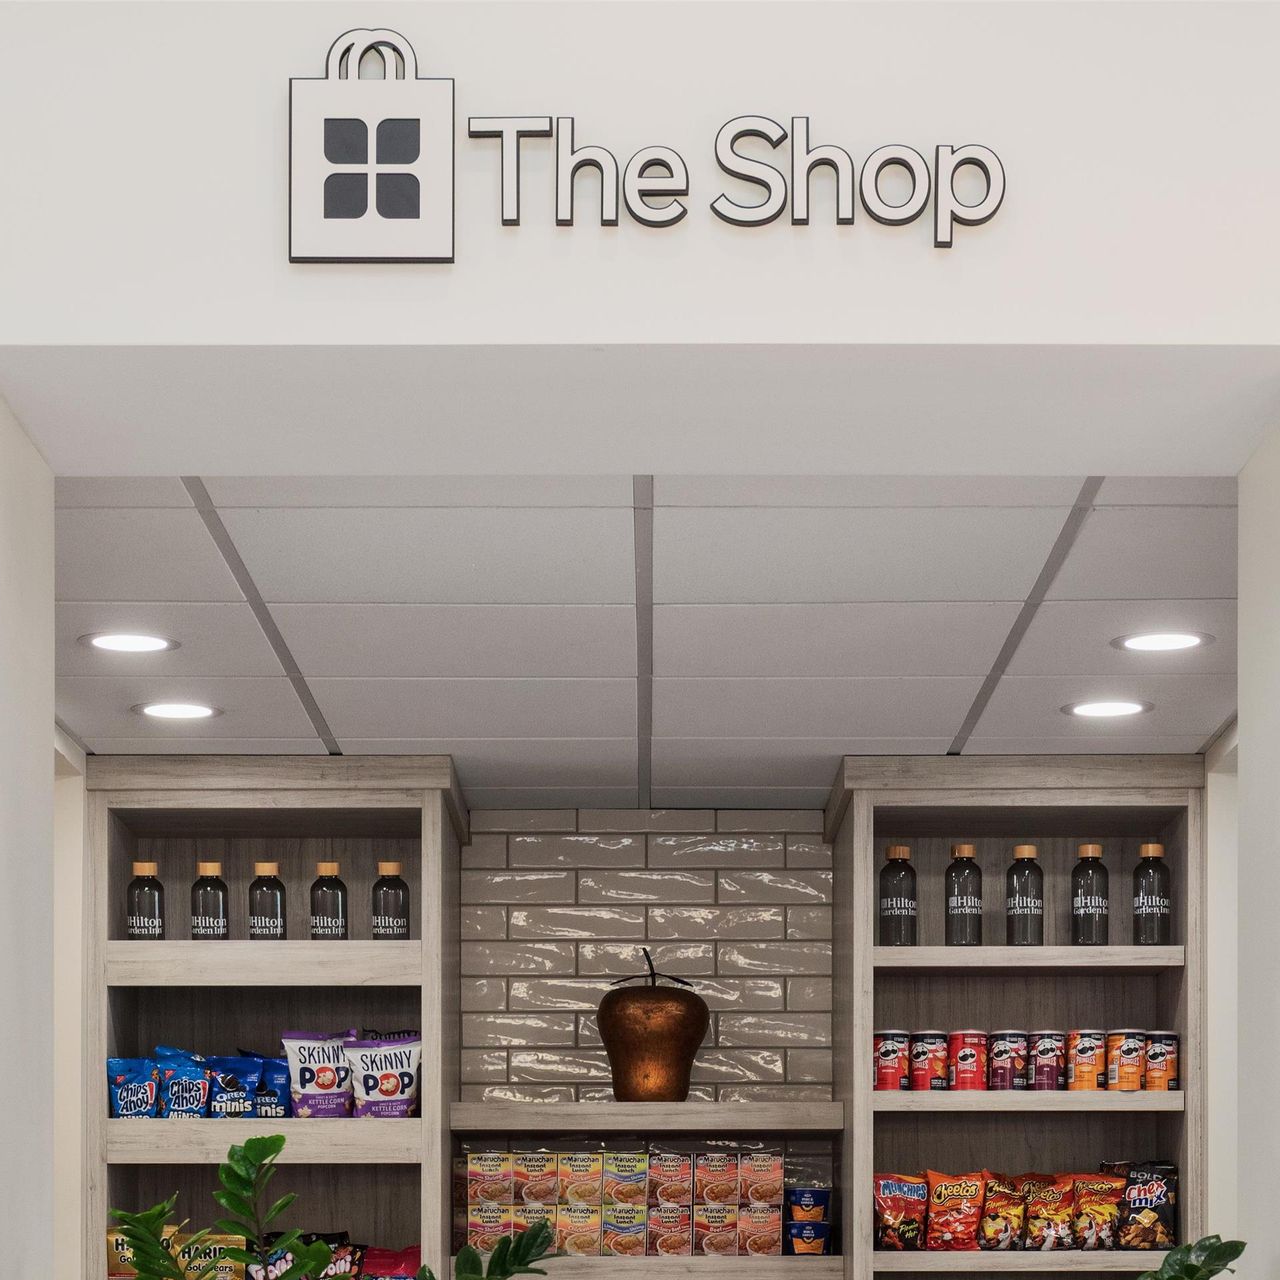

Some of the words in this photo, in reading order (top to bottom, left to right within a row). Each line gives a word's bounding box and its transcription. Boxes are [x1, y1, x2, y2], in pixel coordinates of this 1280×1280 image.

[468, 116, 689, 228] The
[709, 115, 1006, 248] Shop
[887, 898, 917, 908] Hilto
[958, 896, 982, 907] Hilto
[1011, 897, 1042, 908] Hilton
[1082, 896, 1108, 907] Hilto
[949, 906, 977, 915] Garden
[129, 916, 162, 927] Hilton
[194, 916, 227, 927] Hilton
[251, 916, 283, 927] Hilton
[313, 916, 345, 927] Hilton
[375, 916, 407, 927] Hilton
[879, 1059, 898, 1068] PRINGLES
[913, 1060, 929, 1069] PRINGLES
[958, 1062, 976, 1071] PRINGLES
[992, 1059, 1011, 1068] PRINGLES
[1036, 1056, 1056, 1066] PRINGLES
[1076, 1056, 1096, 1066] PRINGLES
[1120, 1056, 1140, 1066] PRINGLES
[1146, 1062, 1167, 1071] PRINGLES
[300, 1066, 350, 1090] POP
[170, 1078, 201, 1098] Chips
[363, 1071, 414, 1097] POP
[118, 1083, 148, 1104] Chips
[119, 1081, 155, 1114] Ahoy!
[171, 1080, 208, 1111] Ahoy!
[216, 1091, 246, 1101] OREO
[211, 1099, 252, 1112] minis
[257, 1105, 285, 1117] inis
[1130, 1171, 1163, 1181] BOLD
[932, 1181, 979, 1205] Cheetos
[1126, 1179, 1167, 1200] Chex
